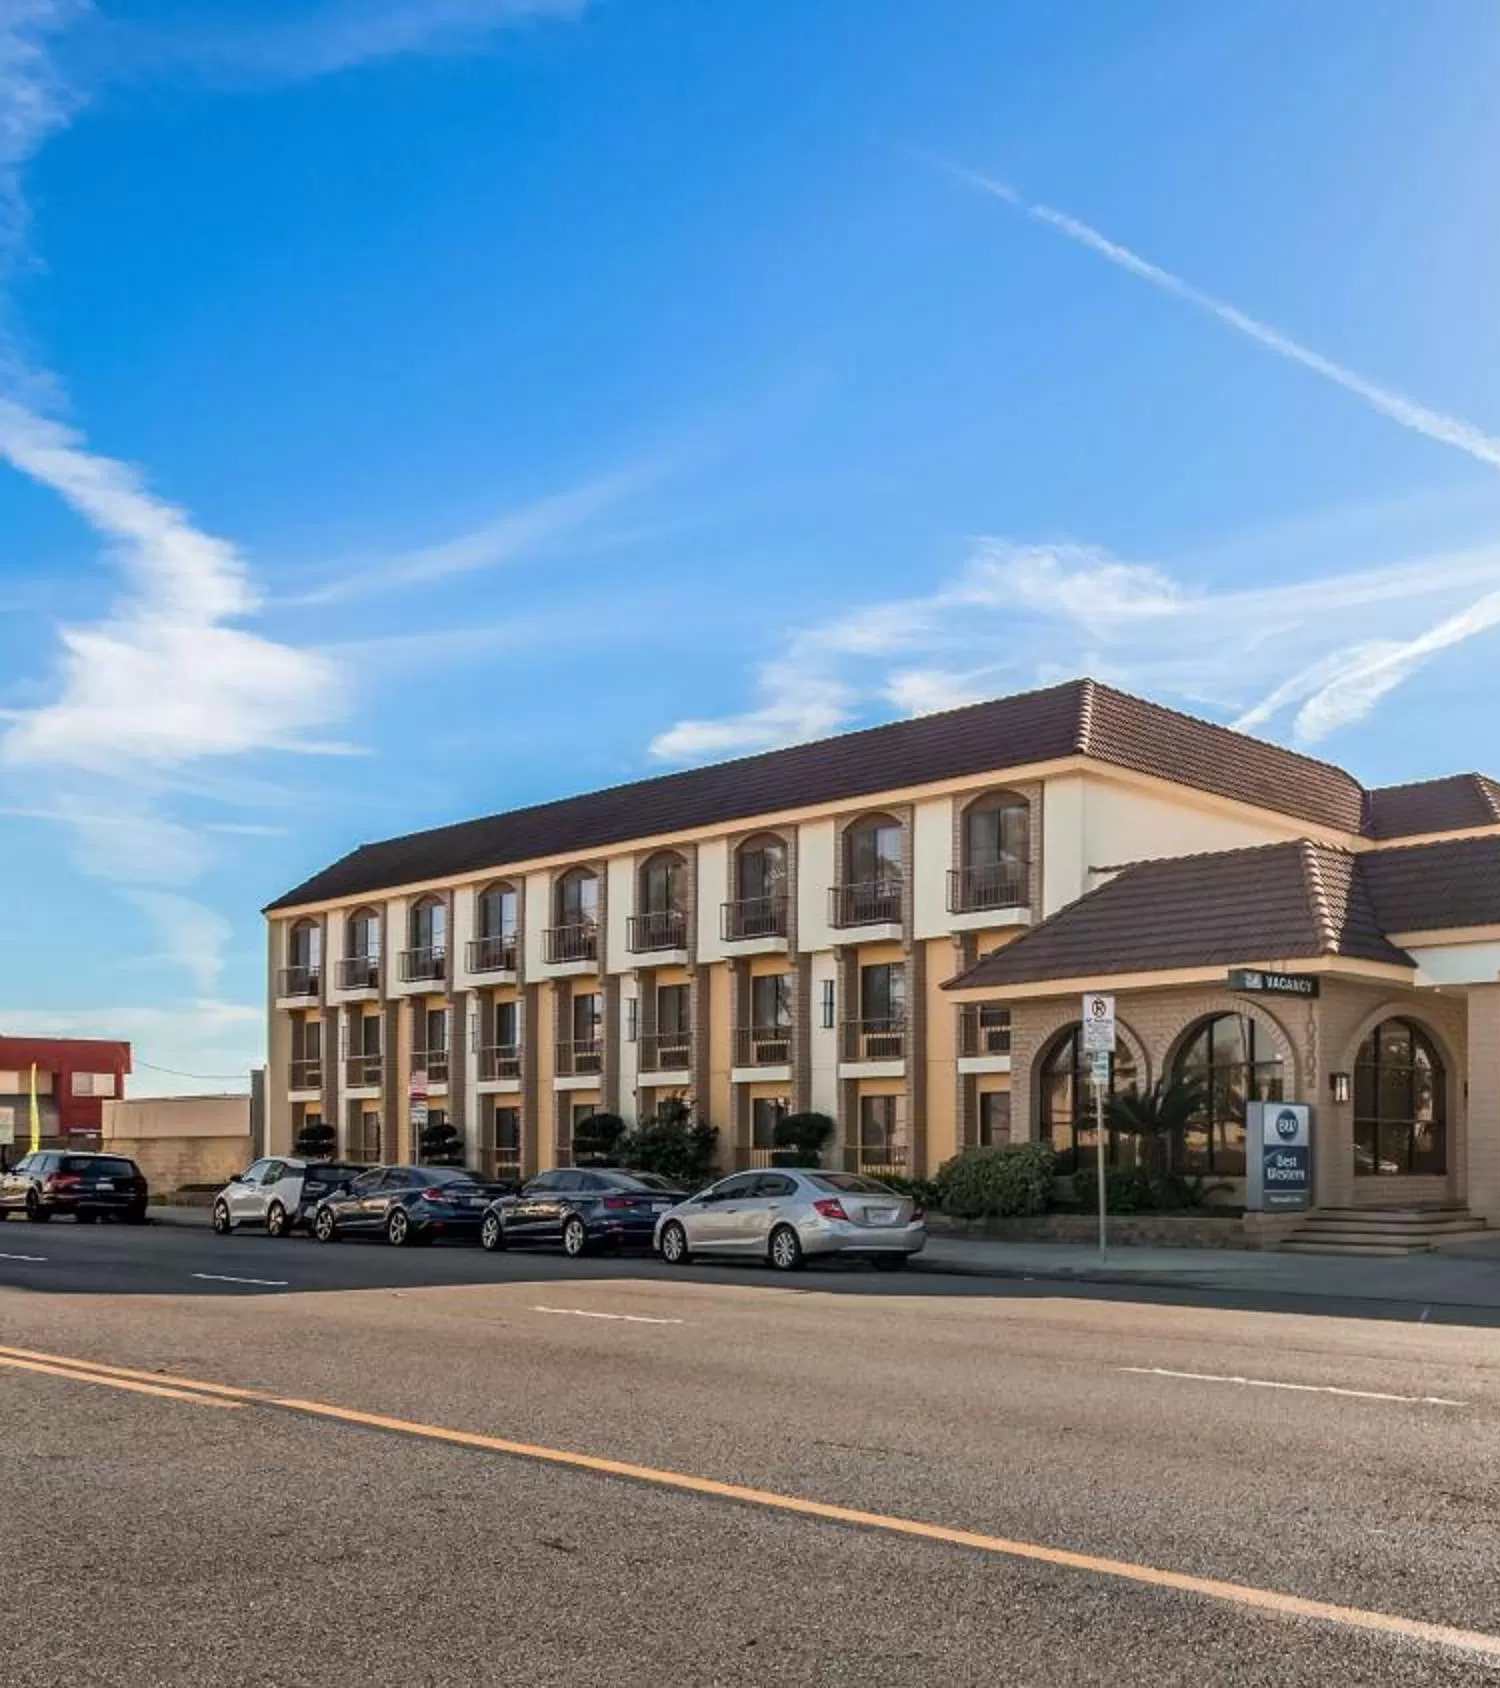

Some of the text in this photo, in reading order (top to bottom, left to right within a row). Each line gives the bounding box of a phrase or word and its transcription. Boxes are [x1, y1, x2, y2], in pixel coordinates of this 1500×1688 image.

[1266, 975, 1312, 992] VACANCY
[1276, 1154, 1297, 1168] Best
[1267, 1167, 1305, 1181] Western
